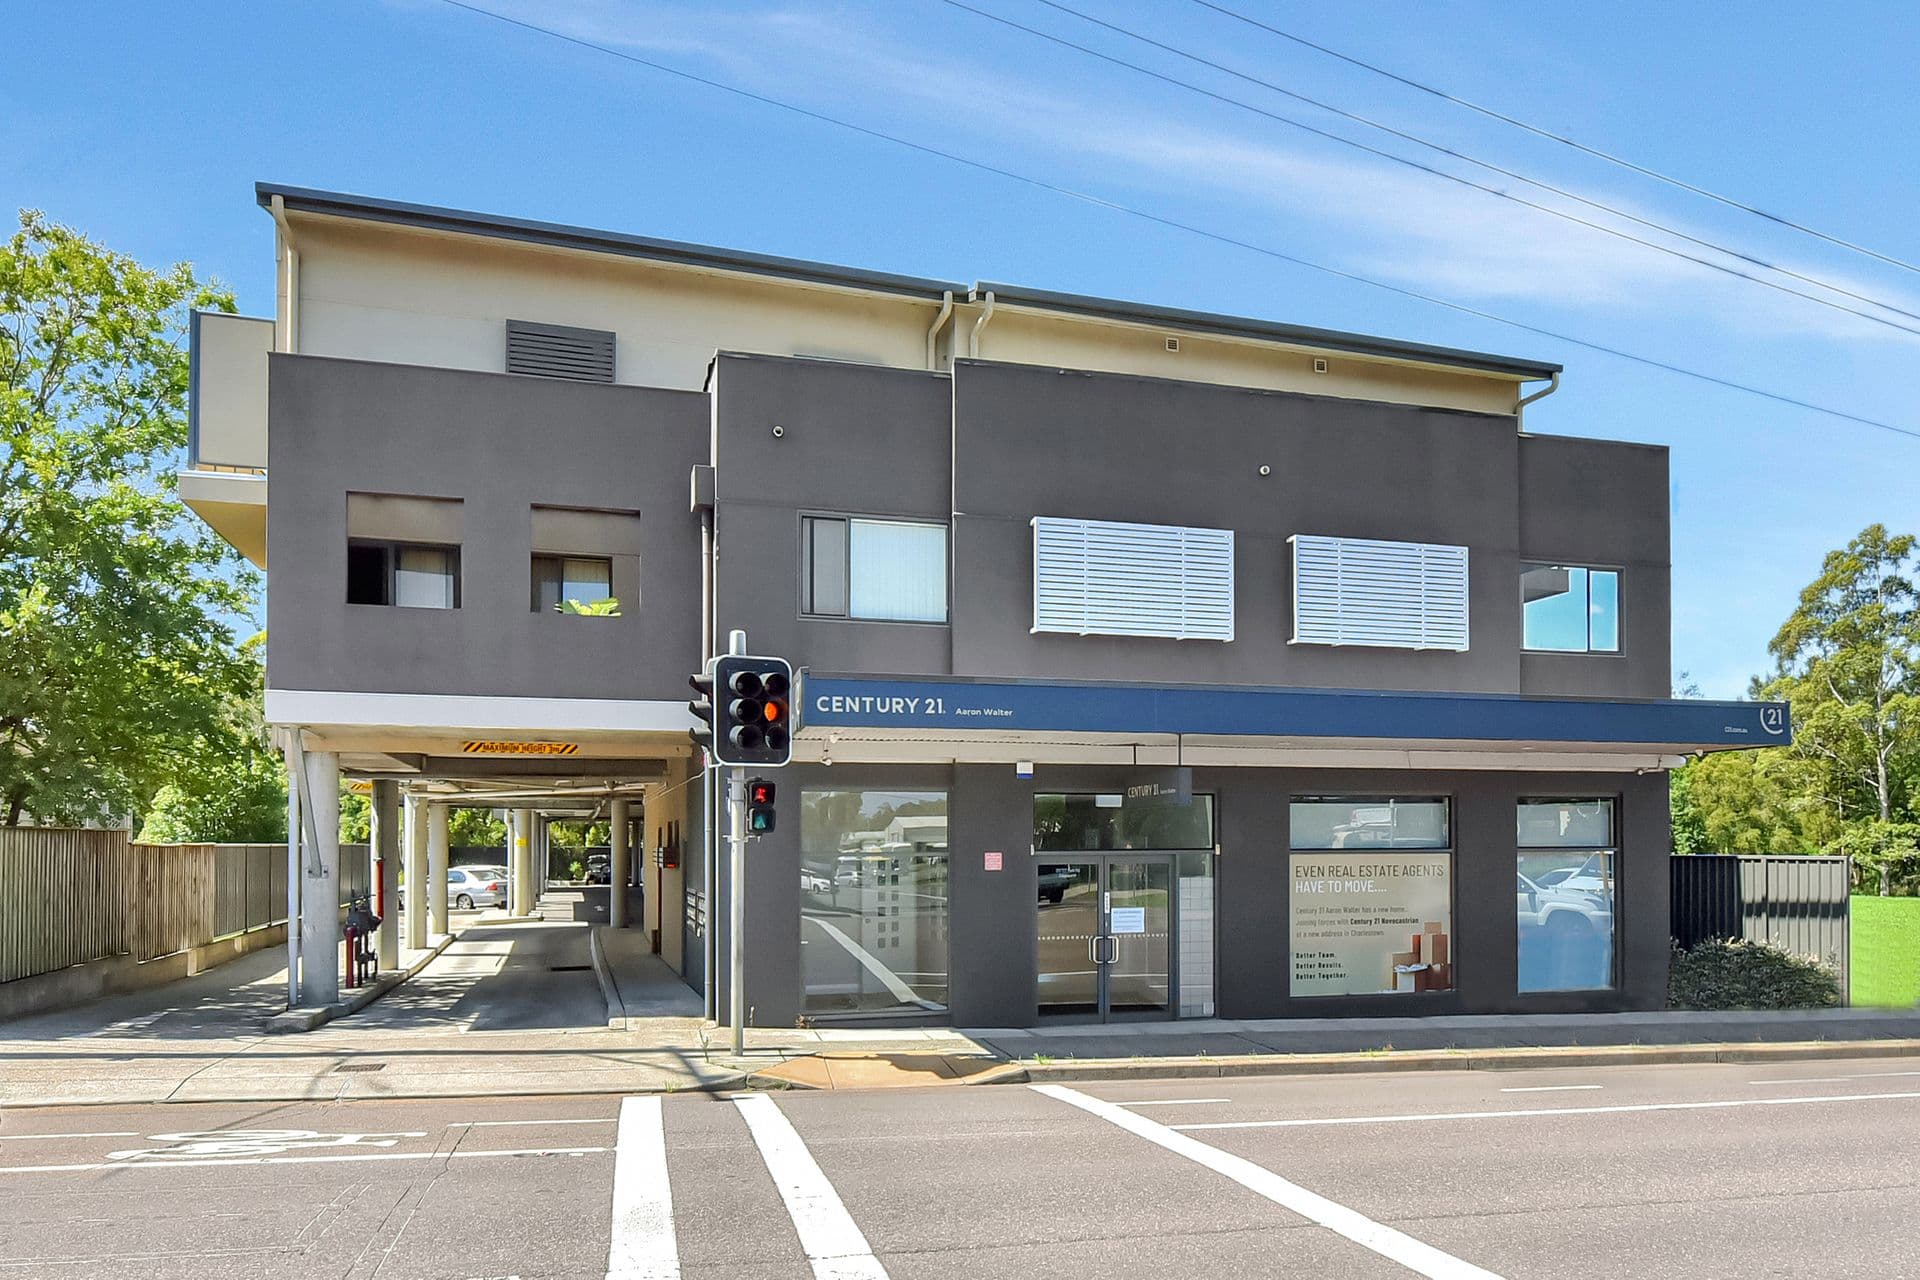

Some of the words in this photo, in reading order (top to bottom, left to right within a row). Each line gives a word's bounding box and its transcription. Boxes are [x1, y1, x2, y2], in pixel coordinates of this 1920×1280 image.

[816, 696, 920, 715] CENTURY
[955, 707, 982, 717] Aaron
[983, 708, 1014, 718] Walter
[483, 743, 520, 753] MAXIMUM
[521, 744, 546, 753] HEIGHT
[1127, 784, 1153, 799] CENTURY
[1295, 865, 1325, 878] EVEN
[1328, 865, 1355, 877] REAL
[1359, 865, 1399, 877] ESTATE
[1402, 864, 1444, 877] AGENTS
[1295, 880, 1324, 893] HAVE
[1328, 880, 1342, 893] TO
[1296, 907, 1317, 916] Century
[1362, 906, 1372, 914] has
[1337, 918, 1349, 926] with
[1350, 918, 1373, 927] Century
[1381, 917, 1419, 925] Novocastrian
[1321, 930, 1343, 938] address
